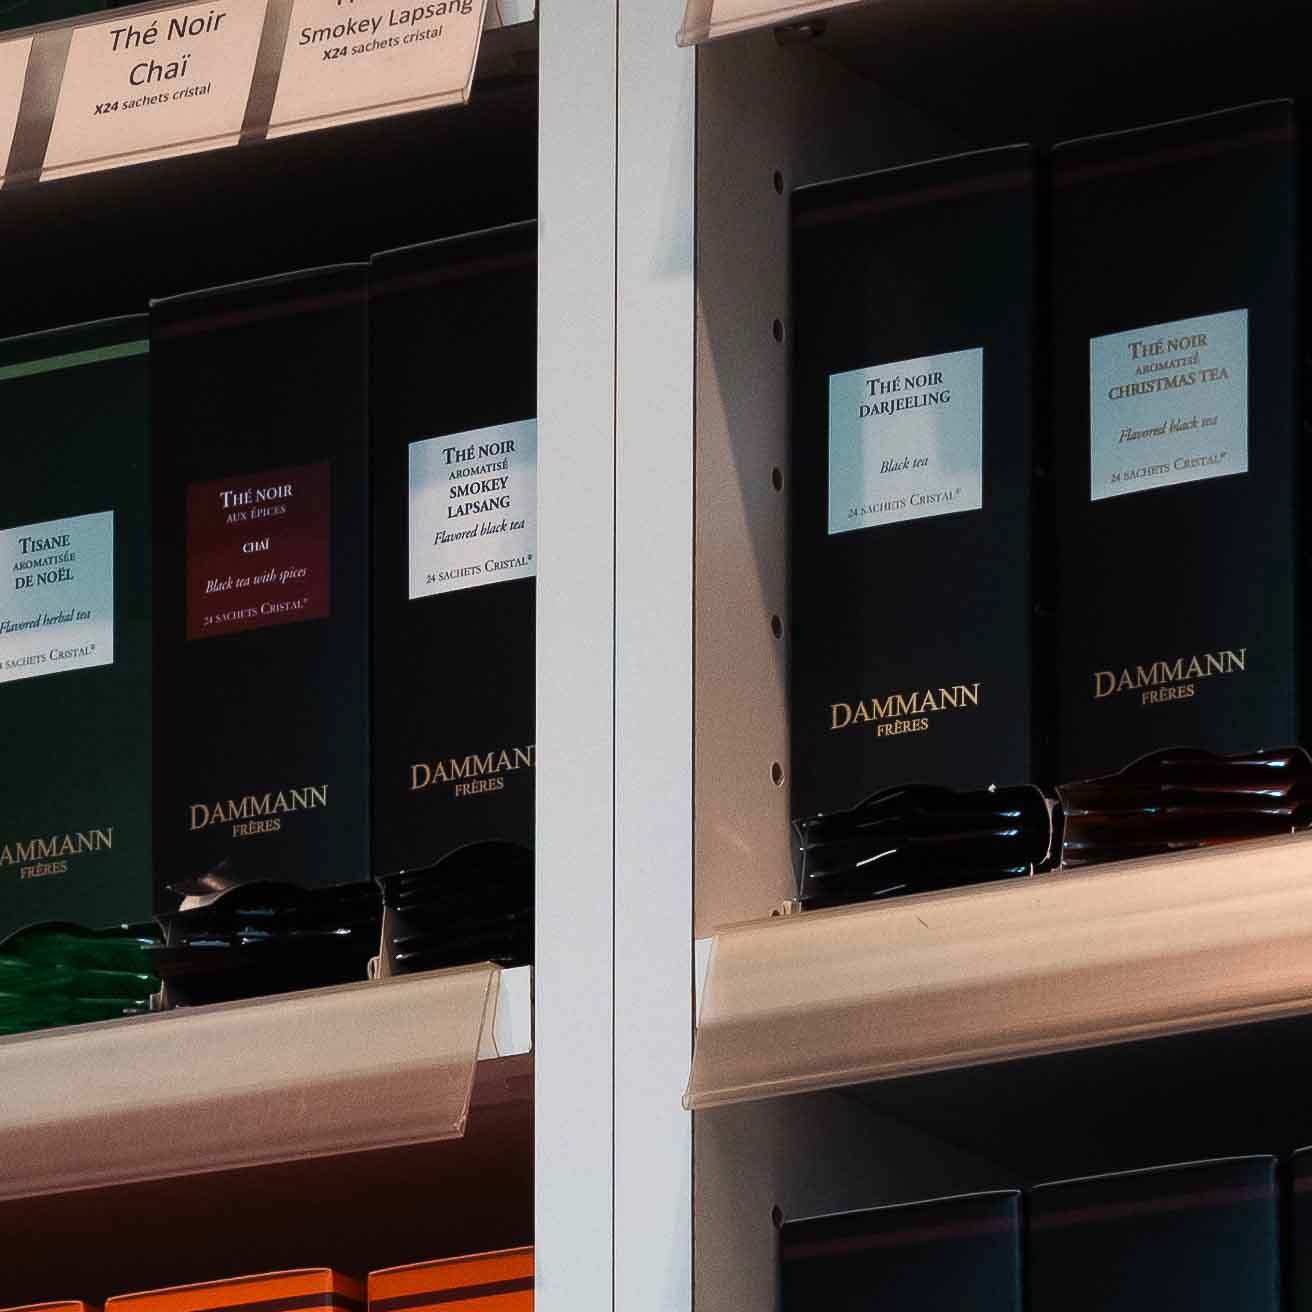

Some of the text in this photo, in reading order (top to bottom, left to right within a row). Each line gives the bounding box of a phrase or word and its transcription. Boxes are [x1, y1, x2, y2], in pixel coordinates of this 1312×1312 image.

[110, 10, 226, 53] Thé Noir
[298, 0, 473, 47] Smokey Lapsang
[128, 54, 191, 86] Chaï
[866, 371, 944, 397] THÉ NOIR
[1108, 368, 1230, 400] CHRISTMAS TEA
[859, 390, 951, 419] DARJEELING
[443, 440, 516, 465] THÉ NOIR
[879, 455, 929, 474] Black tea
[449, 459, 509, 479] AROMATISÉ
[220, 484, 293, 508] THÉ NOIR
[449, 477, 509, 499] SMOKEY
[447, 496, 510, 519] LAPSANG
[18, 535, 70, 554] TISANE
[243, 539, 269, 553] CHAÏ
[13, 551, 76, 571] AROMATISÉE
[15, 567, 74, 590] DE NOËL
[0, 608, 91, 634] Flavored herbal tea
[830, 683, 980, 730] DAMMANN
[189, 784, 329, 833] DAMMANN
